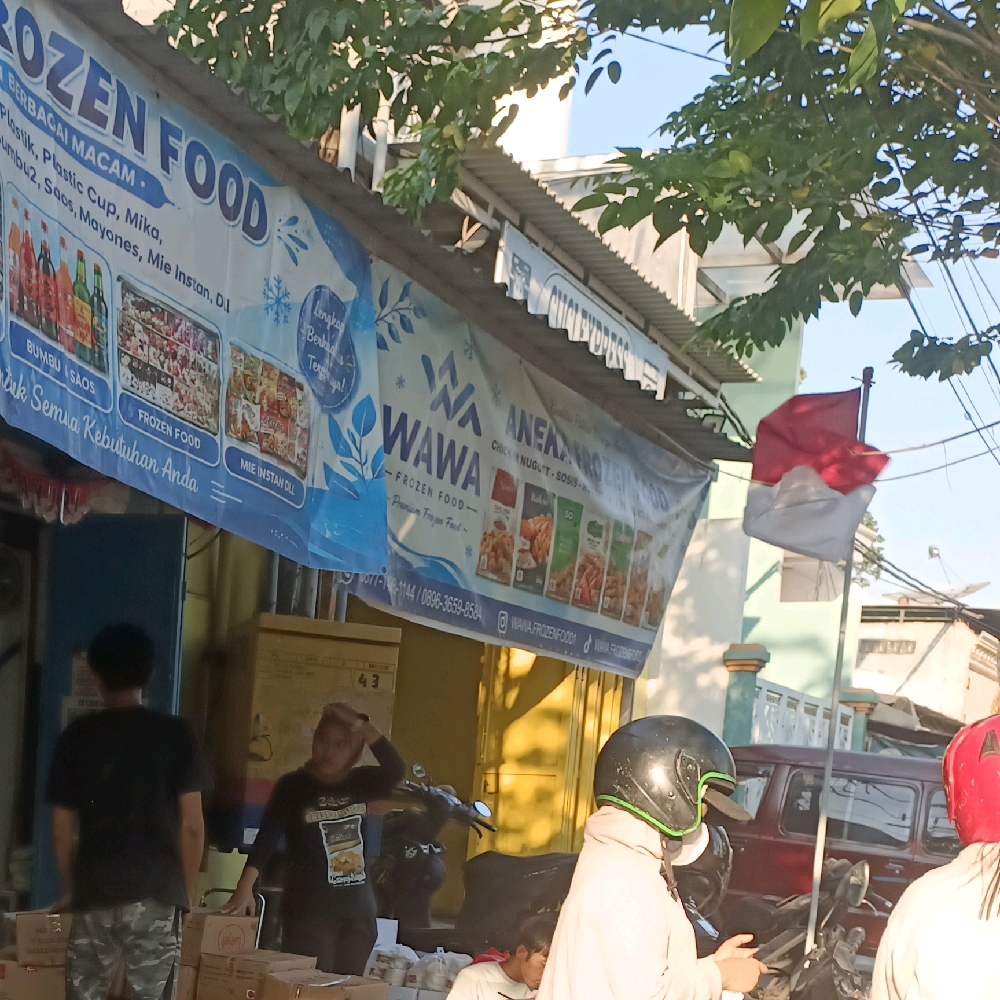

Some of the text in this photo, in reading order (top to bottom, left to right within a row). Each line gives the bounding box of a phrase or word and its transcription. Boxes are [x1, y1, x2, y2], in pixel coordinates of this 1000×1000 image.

[0, 102, 38, 160] Plastik,
[43, 147, 83, 196] Plastic
[88, 186, 120, 223] Cup,
[125, 208, 163, 245] Mika,
[8, 72, 68, 145] BERBAGAI
[71, 136, 136, 187] MACAM
[160, 116, 268, 242] FOOD
[44, 178, 77, 218] Saos,
[79, 209, 142, 262] Mayones,
[147, 249, 172, 275] Mie
[26, 339, 61, 373] BUMBU
[70, 371, 96, 395] SAOS
[30, 384, 80, 435] Semua
[83, 415, 160, 474] Kebutuhan
[162, 457, 199, 493] Anda
[138, 409, 201, 450] FROZEN FOOD
[240, 457, 256, 477] MIE
[257, 465, 284, 490] INSTAN
[383, 404, 481, 498] WAWA
[391, 495, 421, 517] Premium
[423, 507, 444, 529] Frozen
[395, 471, 434, 497] FROZEN
[438, 490, 465, 511] FOOD
